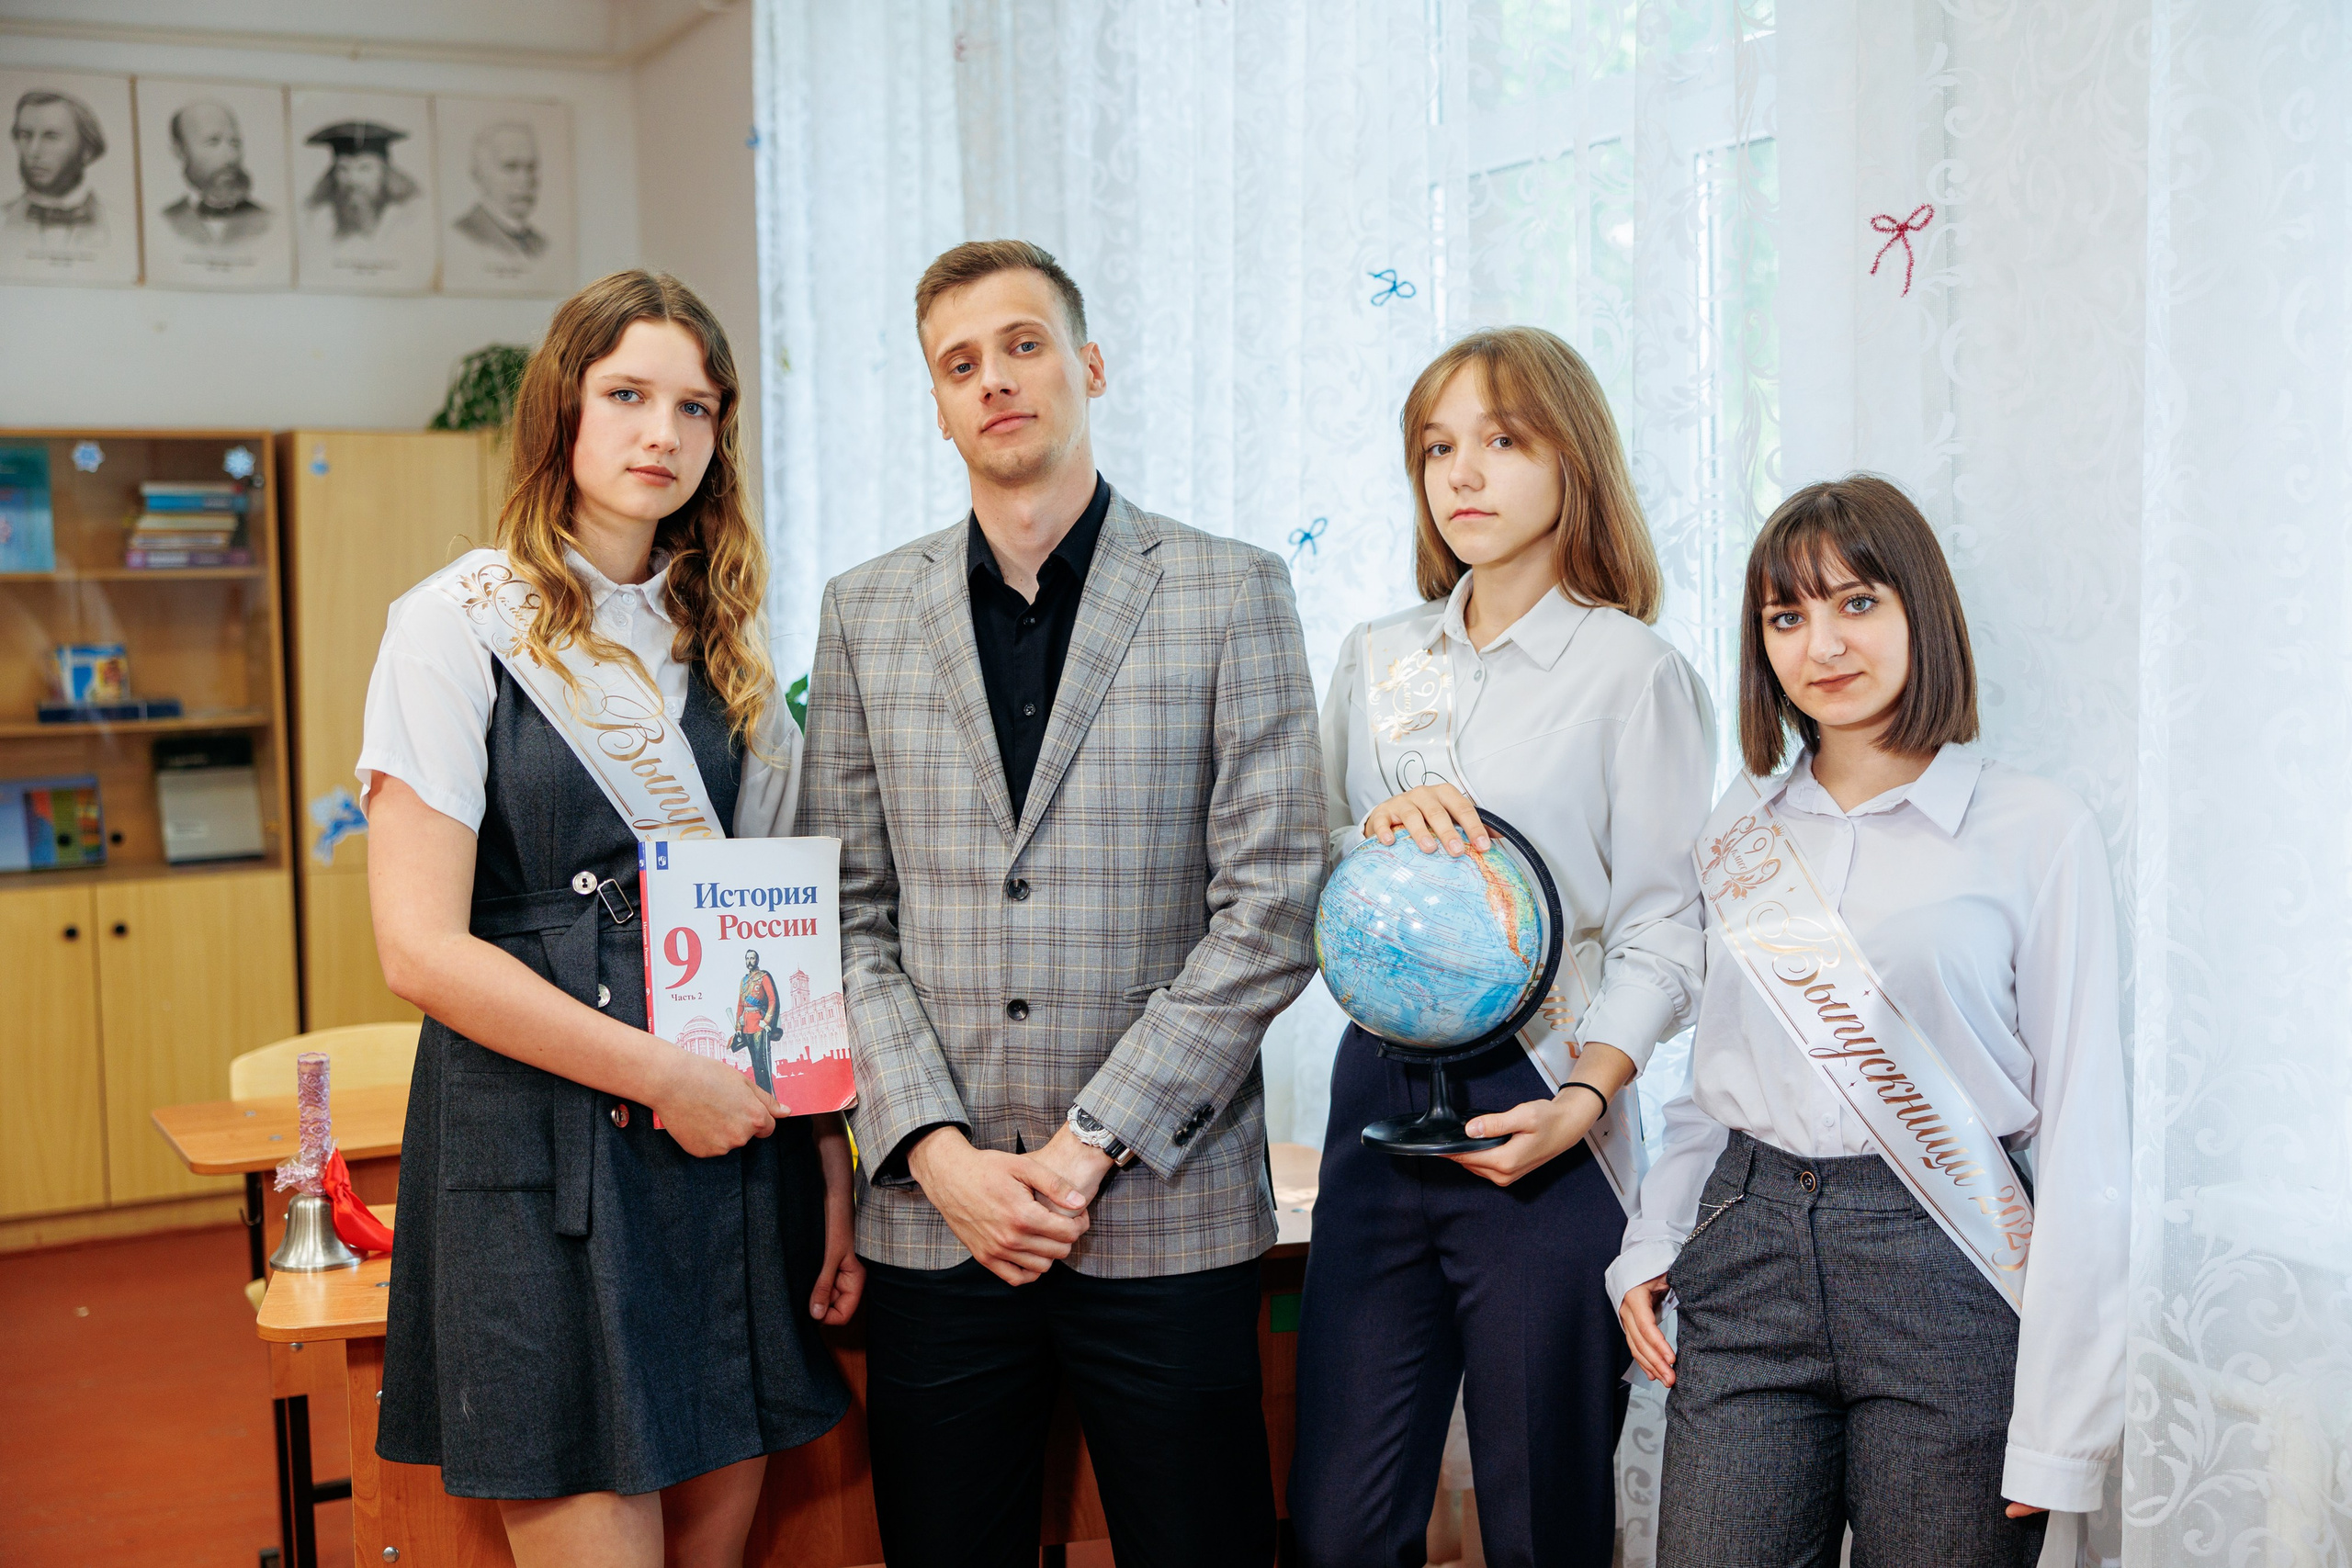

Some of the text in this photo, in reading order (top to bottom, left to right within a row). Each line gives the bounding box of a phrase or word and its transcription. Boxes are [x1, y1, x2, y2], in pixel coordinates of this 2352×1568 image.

[1413, 681, 1435, 698] 9
[562, 675, 718, 840] Выпус
[1744, 837, 1768, 855] 9
[693, 882, 818, 912] История
[718, 914, 818, 941] России
[663, 926, 703, 990] 9
[671, 991, 703, 1002] Часть 2
[1746, 900, 2034, 1272] Выпускница 2025
